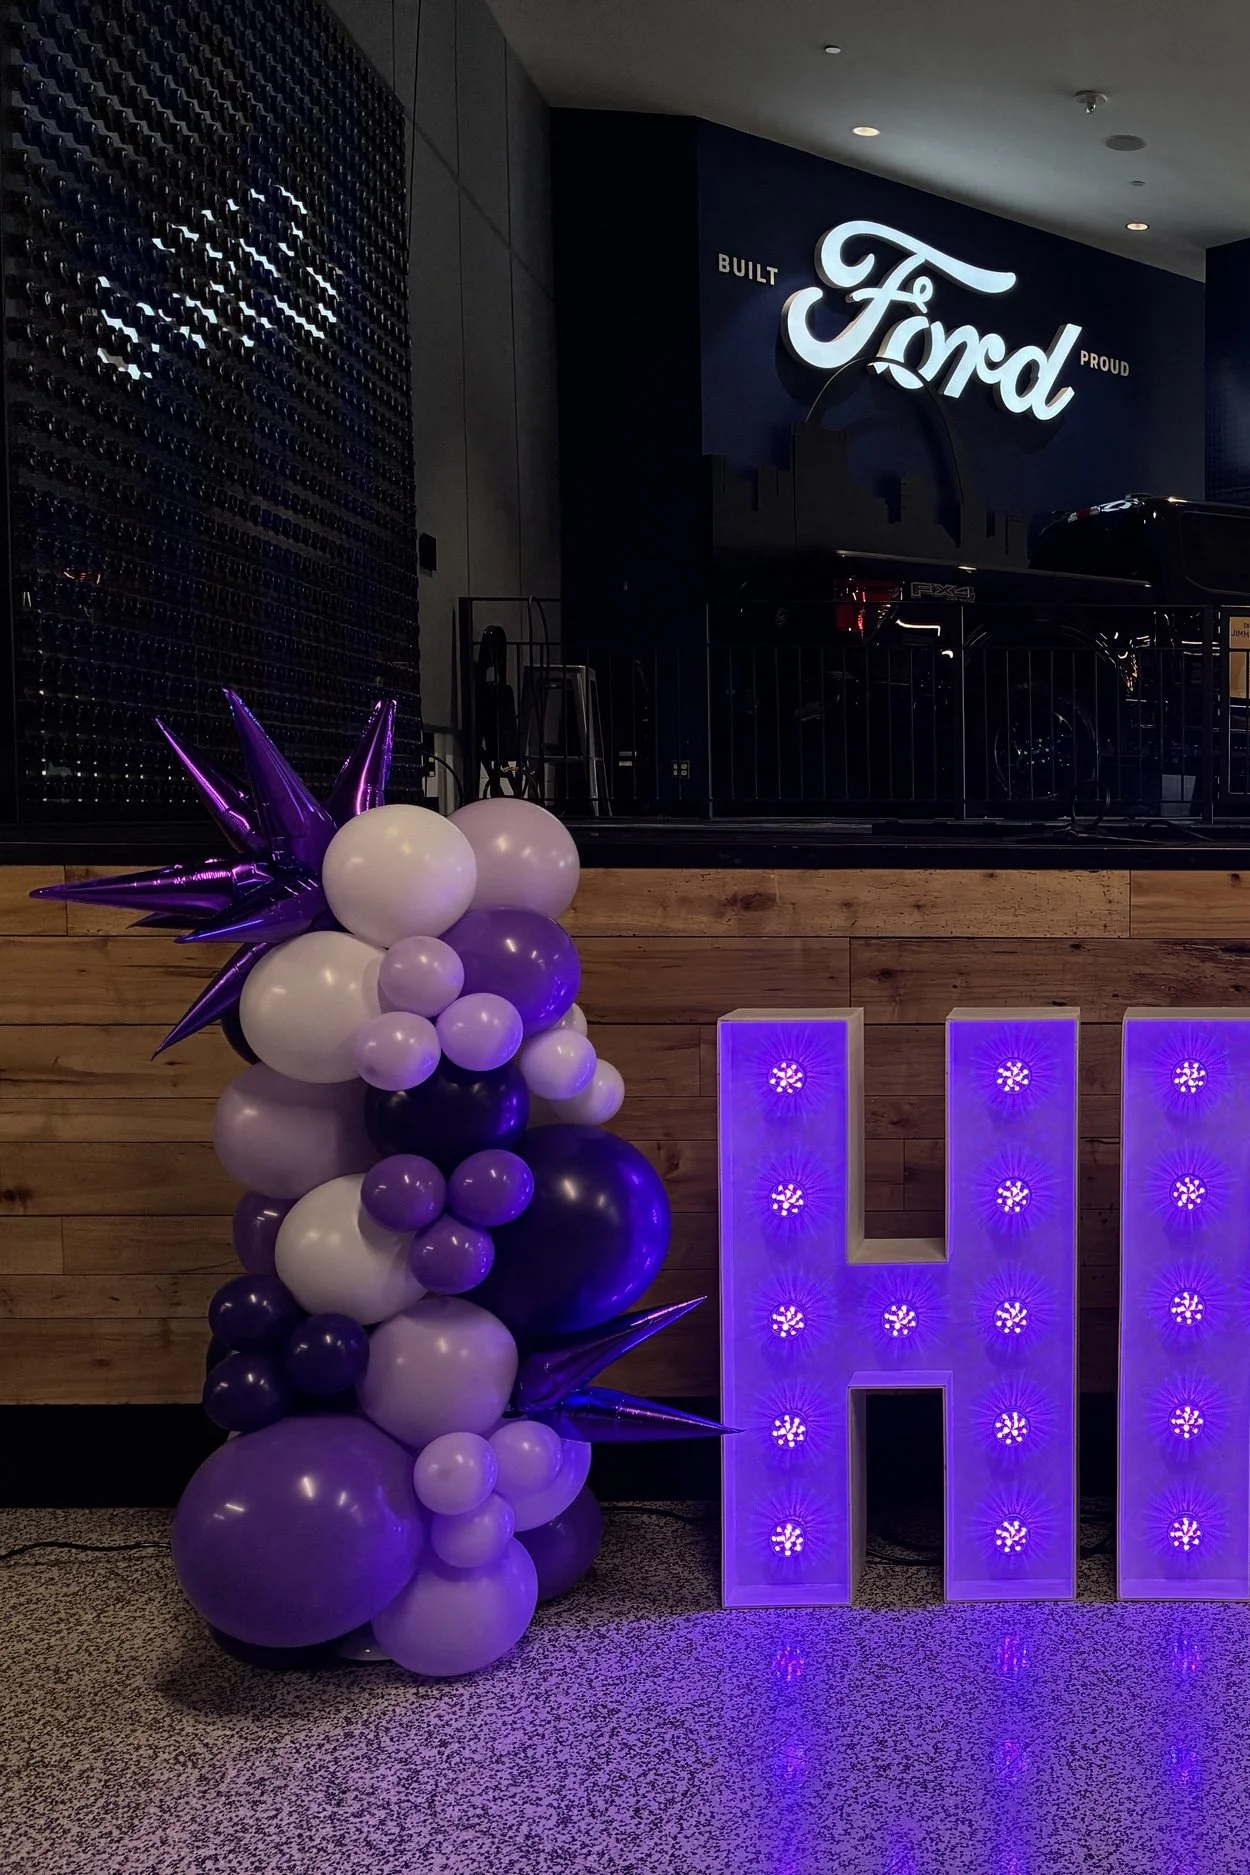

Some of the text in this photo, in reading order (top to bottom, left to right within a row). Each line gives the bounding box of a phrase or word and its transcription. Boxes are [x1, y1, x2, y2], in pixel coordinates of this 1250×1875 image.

[718, 219, 1130, 422] BUILT Ford PROUD
[910, 581, 975, 601] FX4
